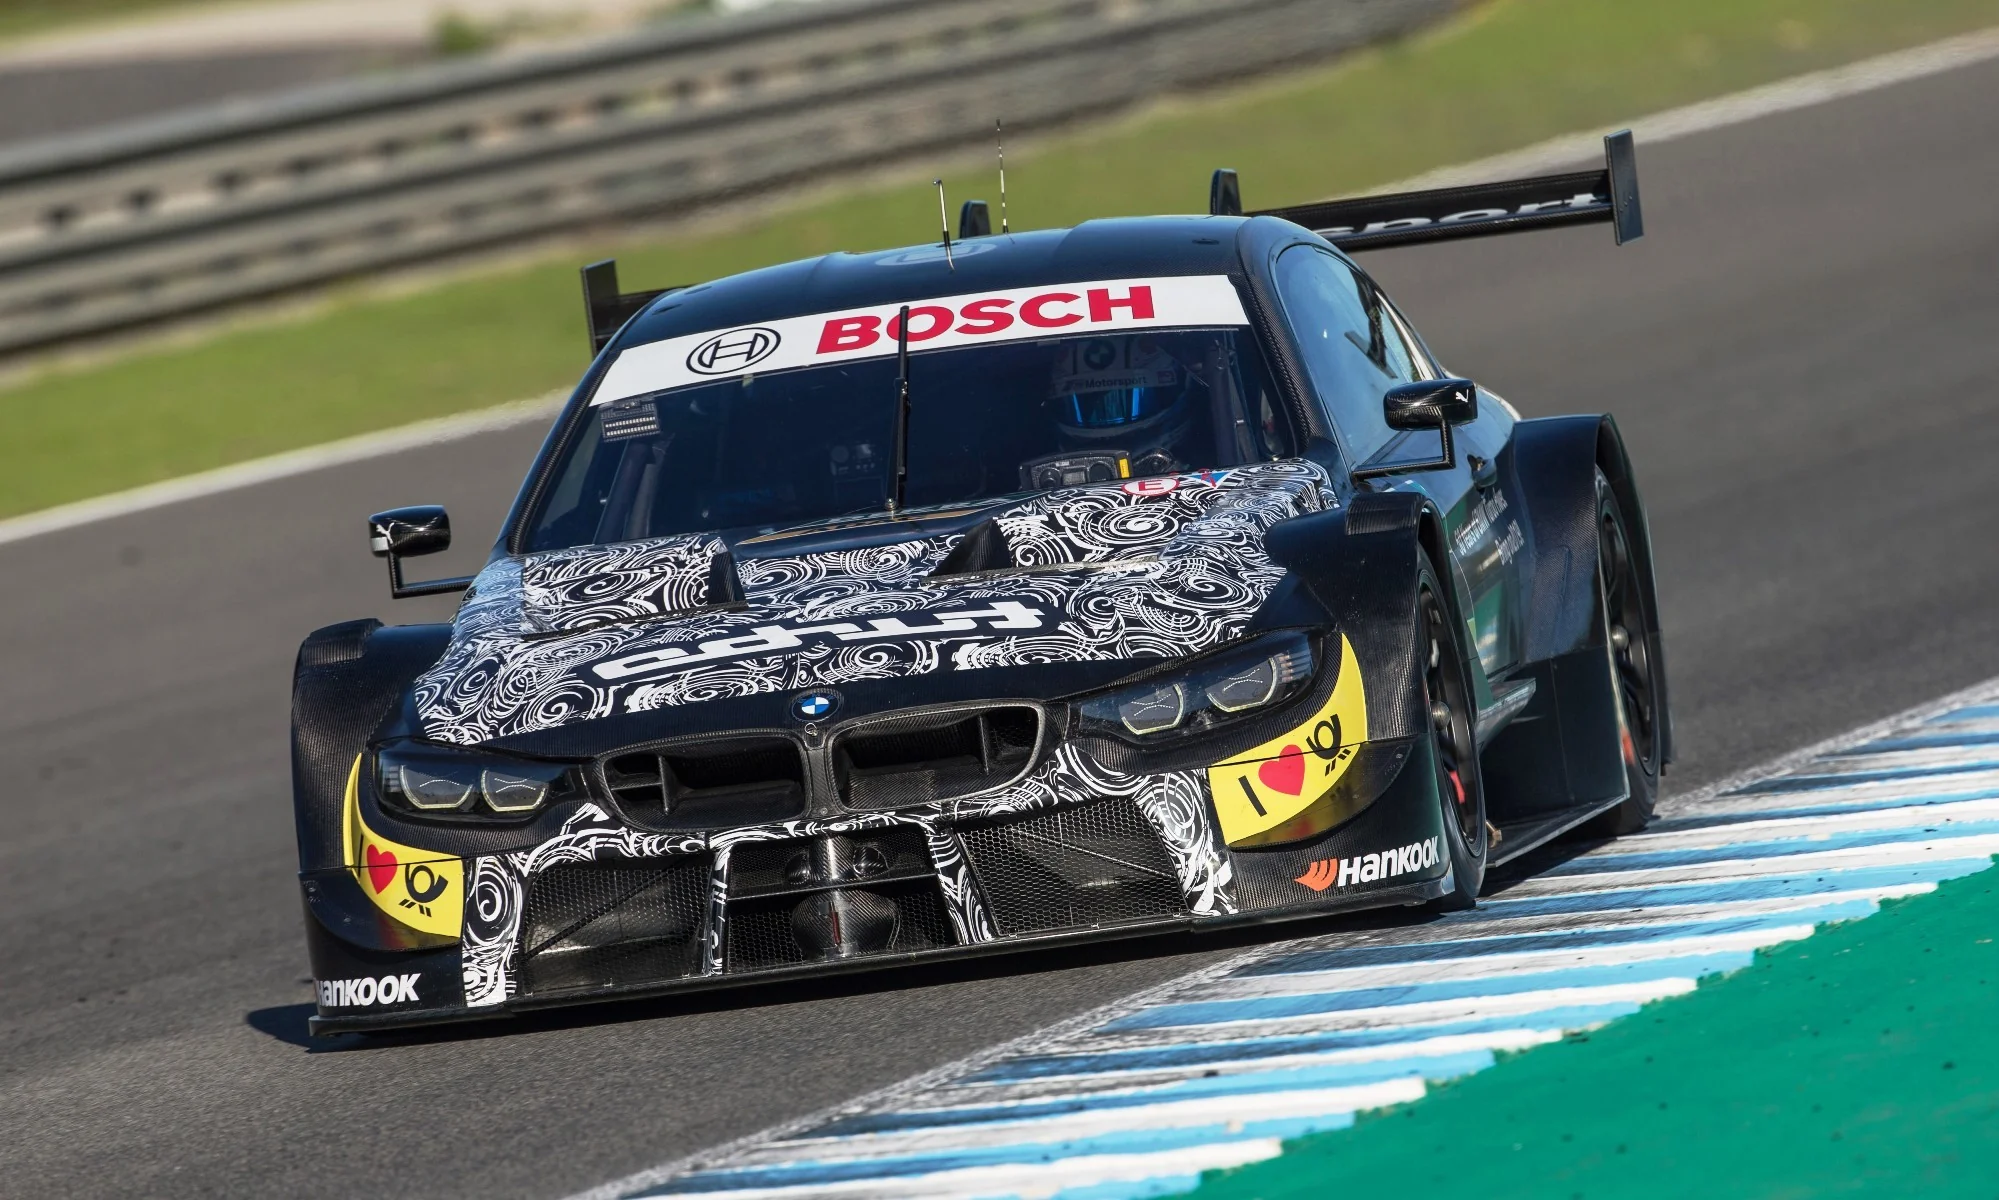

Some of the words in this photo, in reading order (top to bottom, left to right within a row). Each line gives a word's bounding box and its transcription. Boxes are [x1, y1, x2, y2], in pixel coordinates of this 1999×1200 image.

[816, 286, 1155, 355] BOSCH
[1085, 376, 1147, 389] Motorsport
[1138, 480, 1165, 492] E
